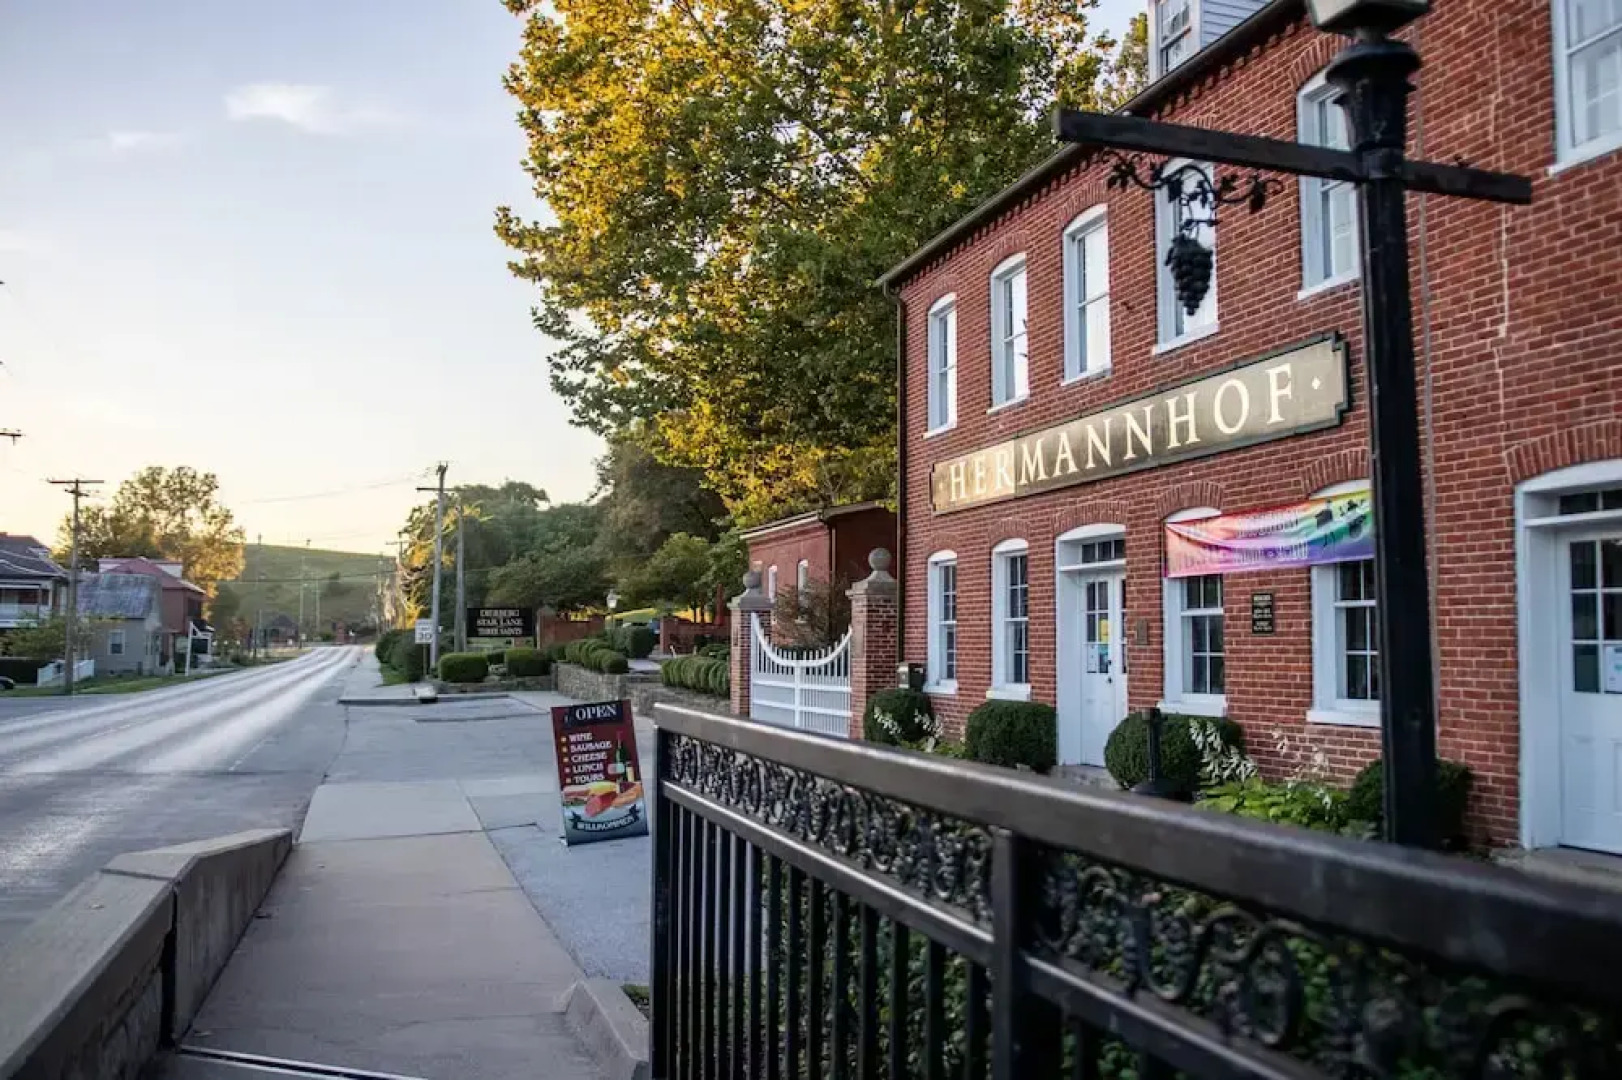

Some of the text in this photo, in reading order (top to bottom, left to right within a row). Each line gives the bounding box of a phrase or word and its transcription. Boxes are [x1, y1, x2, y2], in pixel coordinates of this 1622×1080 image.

[949, 363, 1293, 502] HERMANNHOF
[575, 704, 617, 720] OPEN
[569, 732, 592, 742] WINE
[570, 741, 612, 753] SAUSAGE
[571, 752, 608, 763] CHEESE
[573, 762, 604, 773] LUNCH
